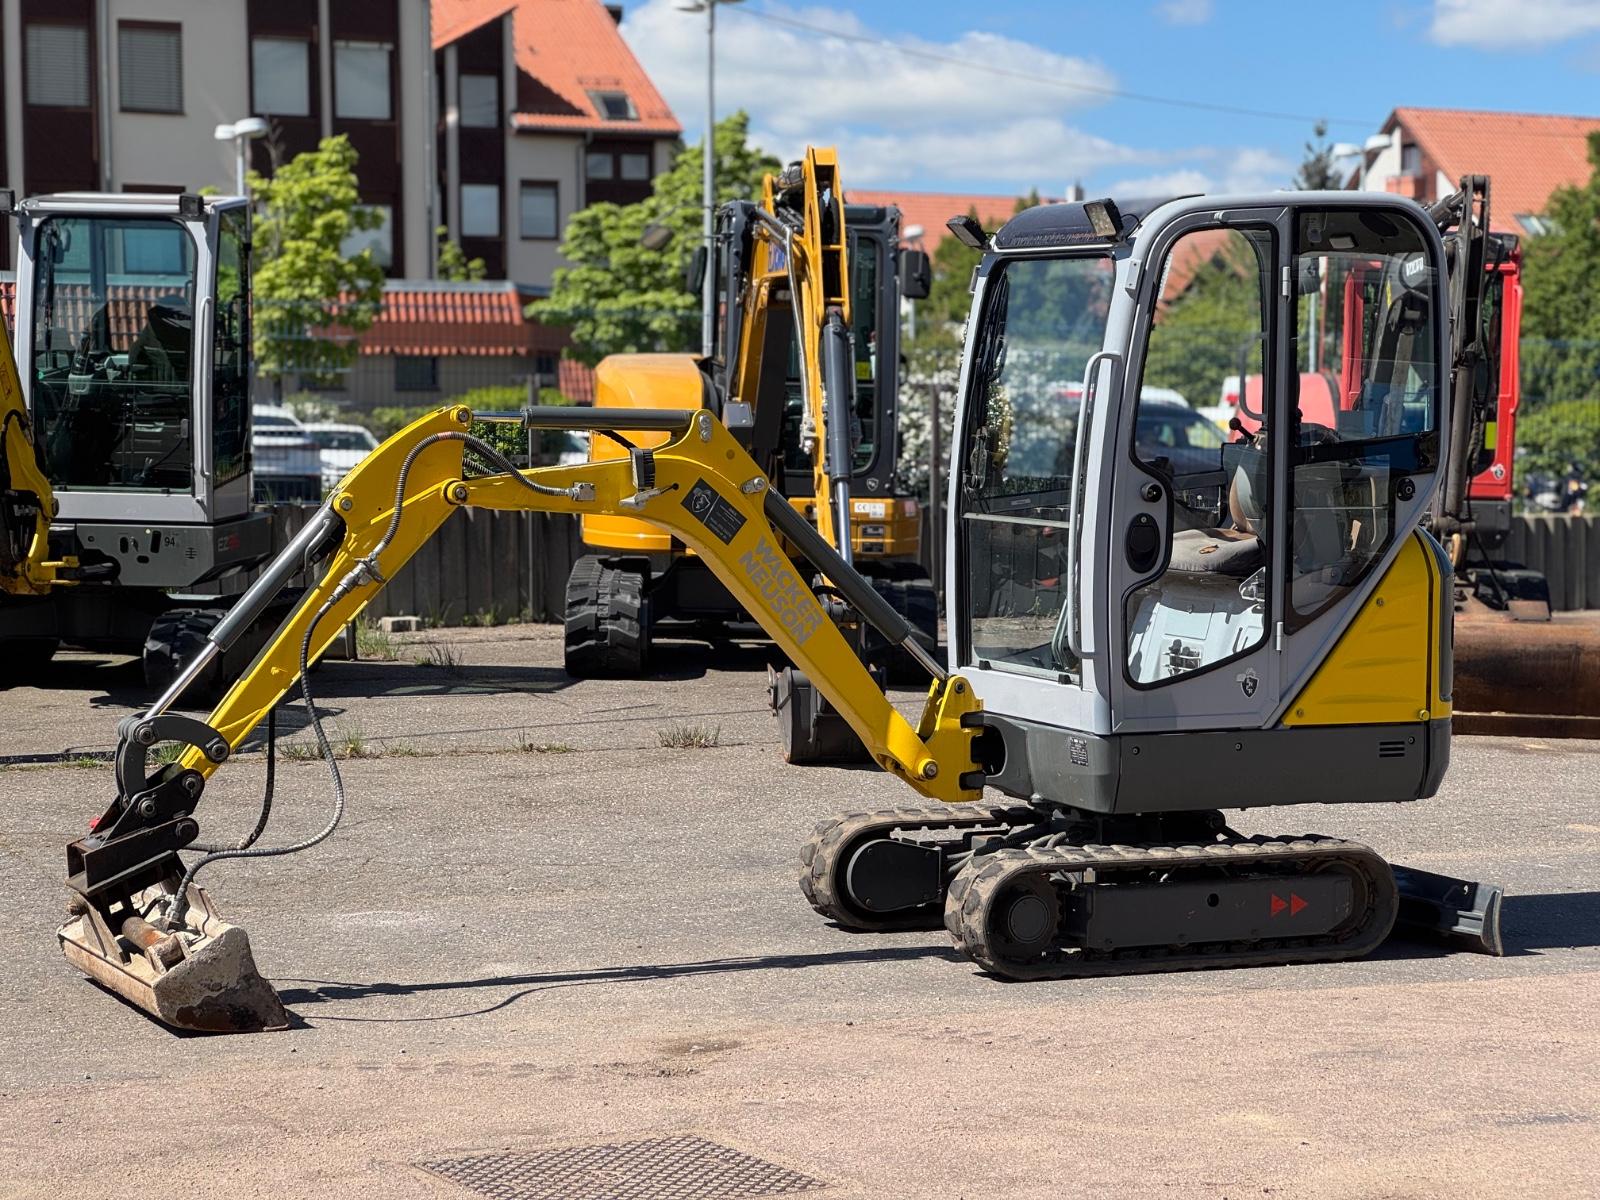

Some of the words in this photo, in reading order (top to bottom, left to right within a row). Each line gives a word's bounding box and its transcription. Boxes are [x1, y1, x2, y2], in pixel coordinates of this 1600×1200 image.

[164, 536, 175, 547] 94
[757, 536, 824, 626] WACKER
[739, 552, 814, 645] NEUSON
